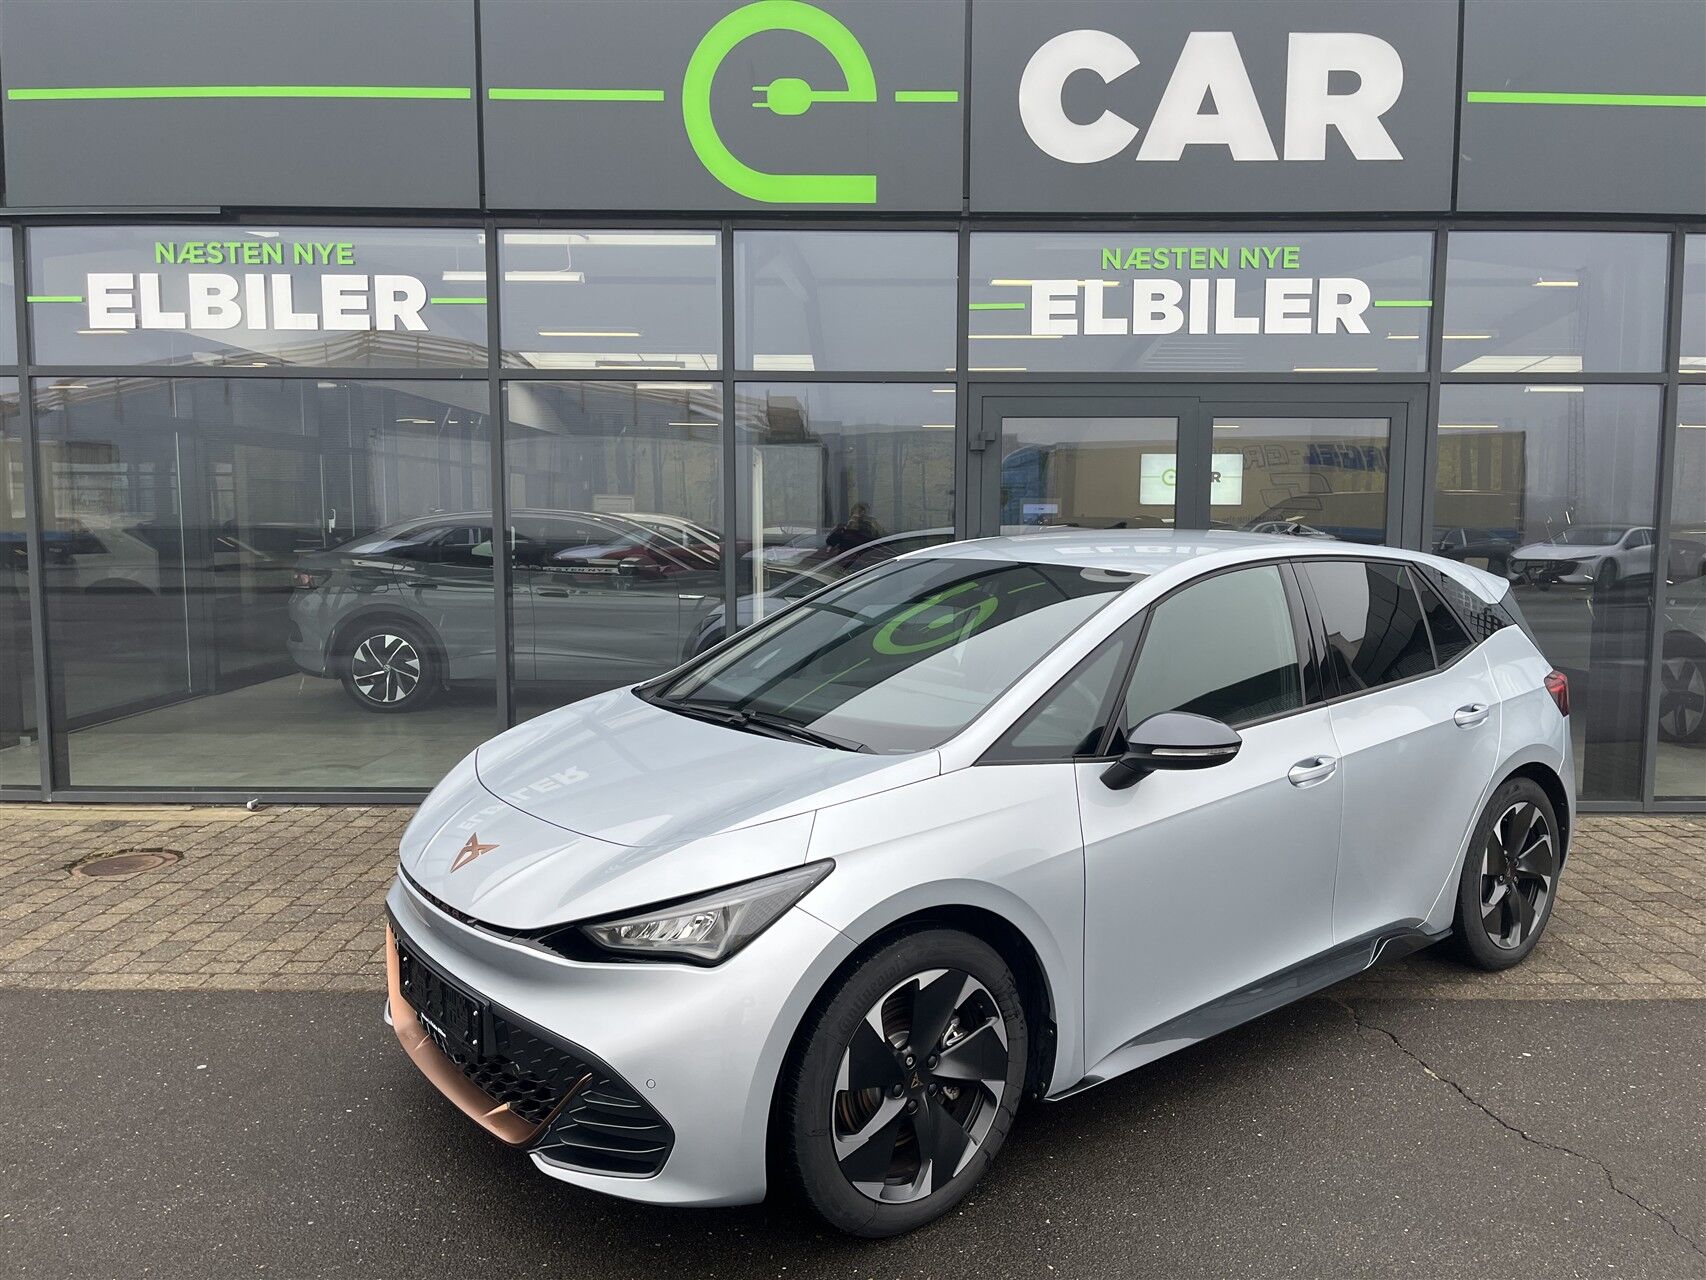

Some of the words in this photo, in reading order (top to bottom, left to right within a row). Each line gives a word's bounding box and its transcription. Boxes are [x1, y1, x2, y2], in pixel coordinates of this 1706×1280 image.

[1018, 29, 1405, 164] CAR
[154, 241, 283, 265] NÆSTEN
[293, 242, 355, 265] NYE
[1101, 246, 1231, 270] NÆSTEN
[1239, 246, 1301, 269] NYE
[86, 271, 430, 332] ELBILER
[1029, 277, 1372, 337] ELBILER
